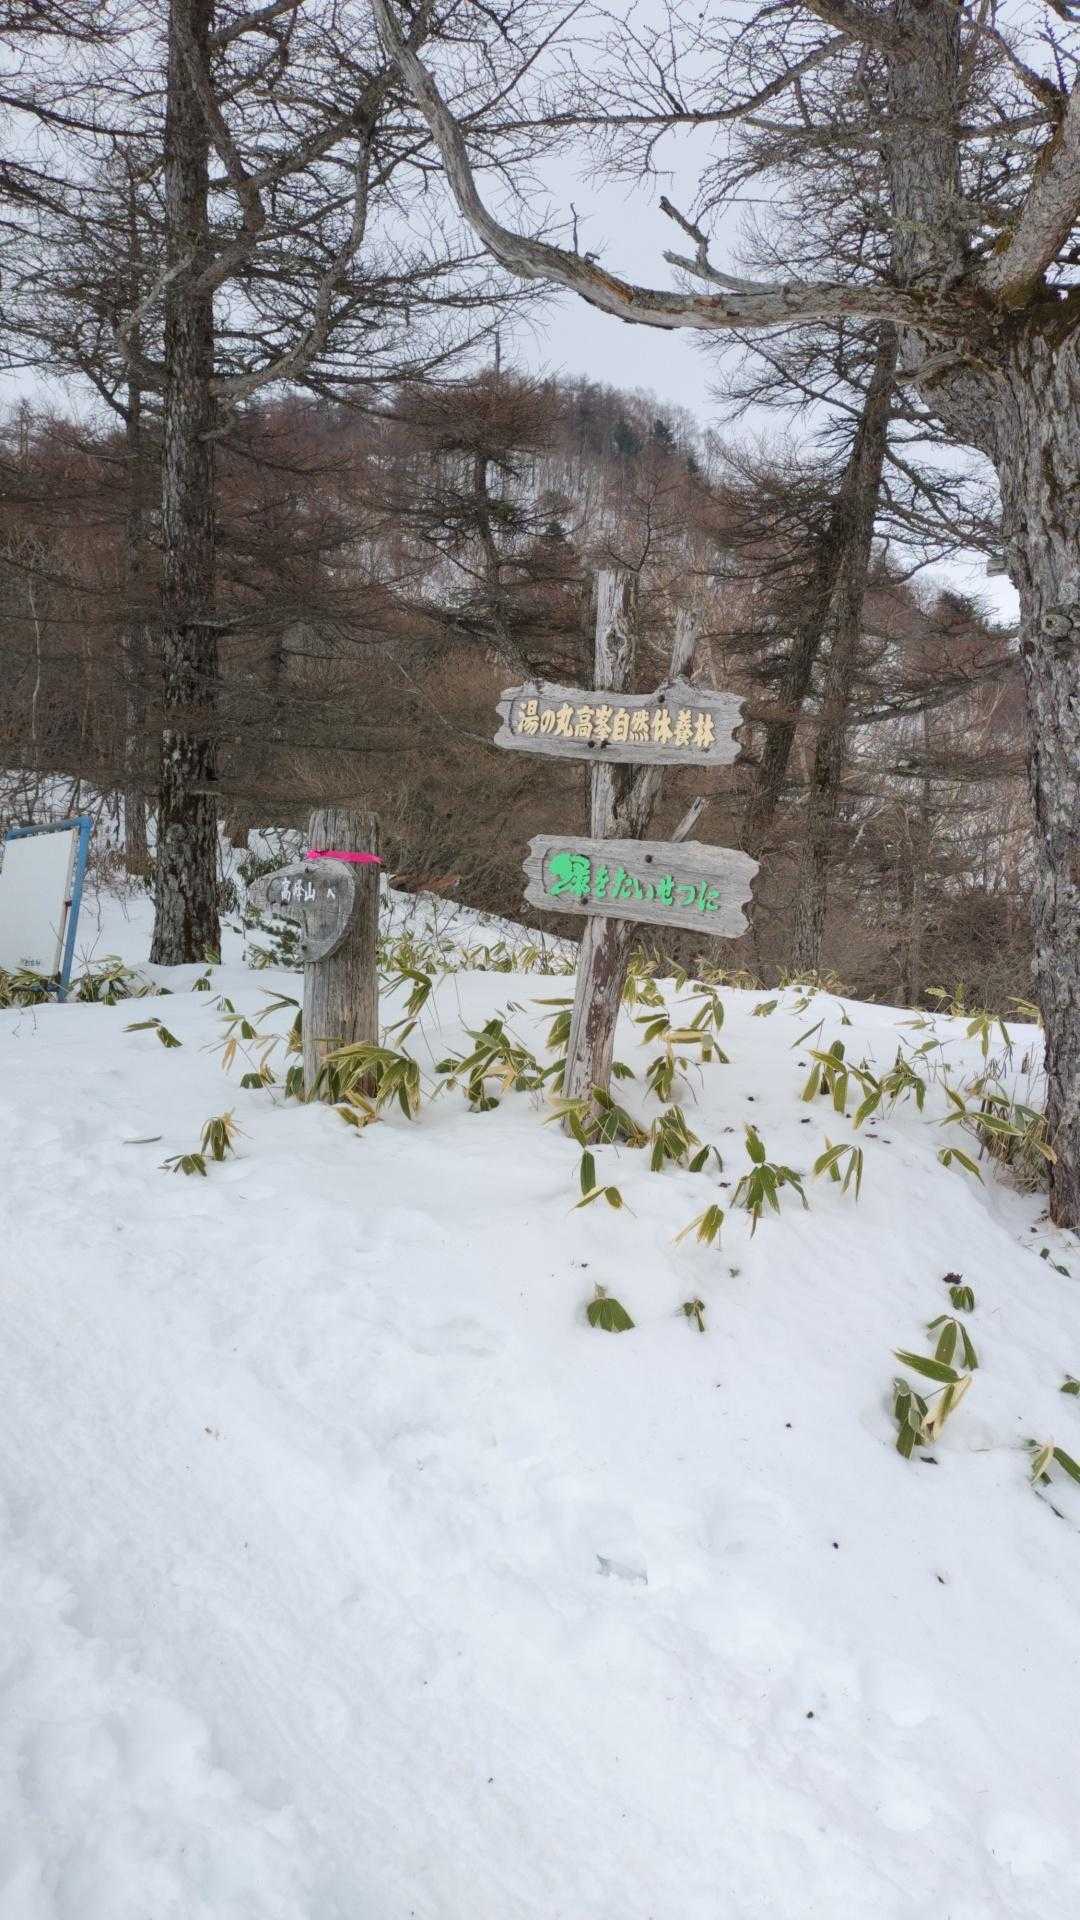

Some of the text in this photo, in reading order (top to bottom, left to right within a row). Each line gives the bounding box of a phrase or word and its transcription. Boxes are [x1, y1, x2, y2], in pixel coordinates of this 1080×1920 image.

[549, 851, 721, 912] 緑をたいせつに
